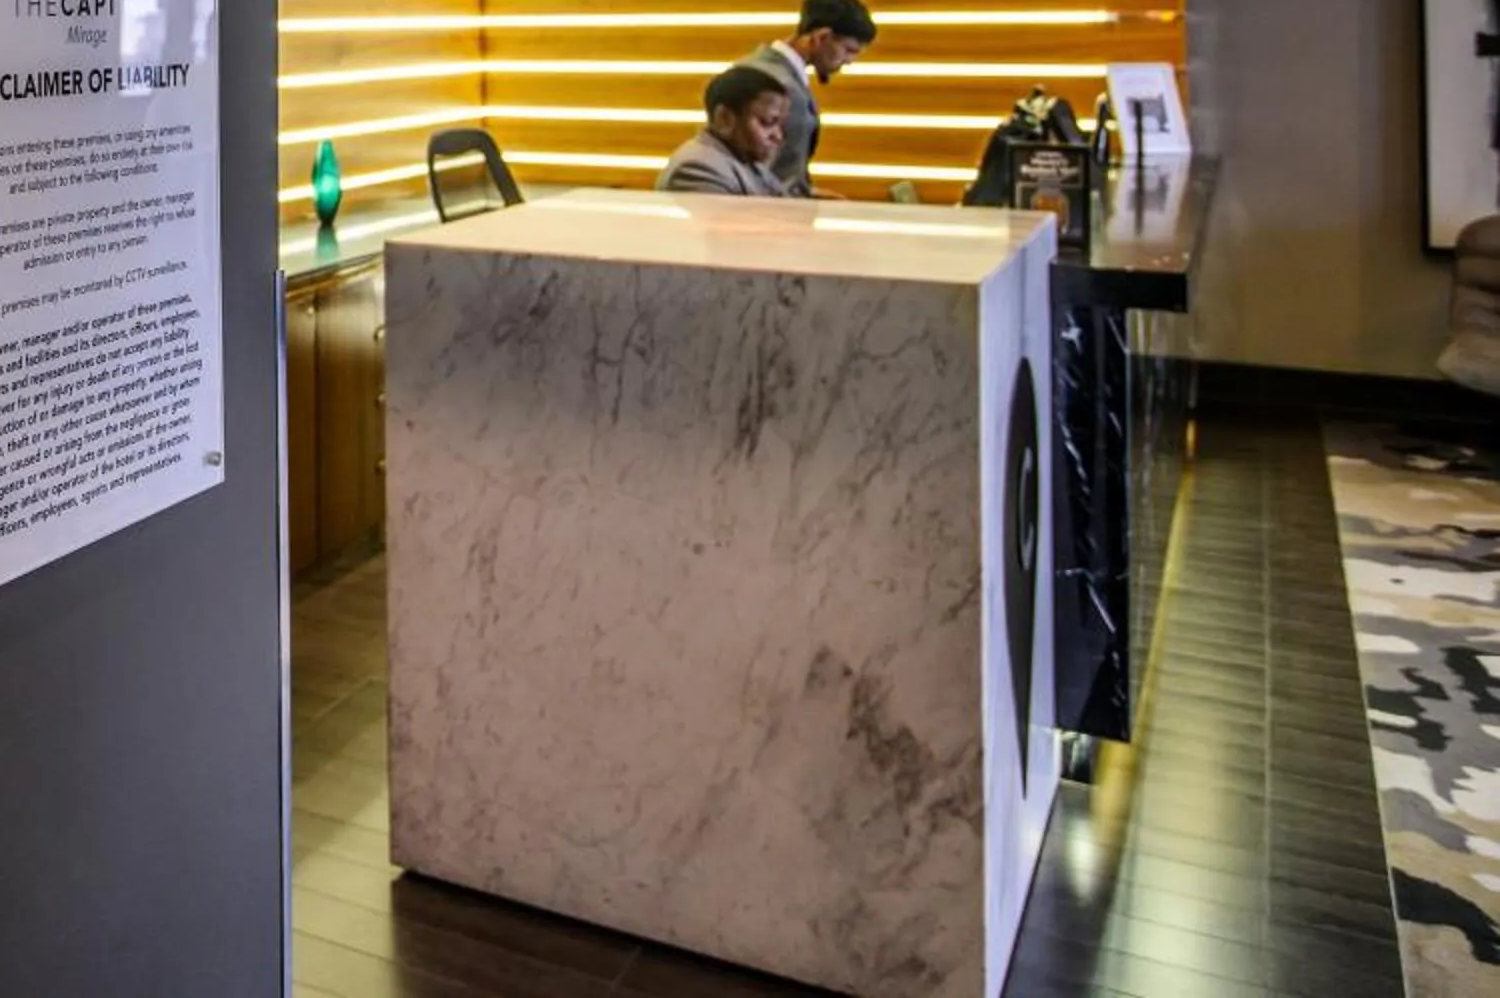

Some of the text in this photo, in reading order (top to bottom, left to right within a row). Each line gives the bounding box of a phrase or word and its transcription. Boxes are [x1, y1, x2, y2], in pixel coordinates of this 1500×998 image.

[66, 24, 108, 47] Mirage
[88, 68, 113, 94] OF
[117, 63, 190, 92] LIABILITY
